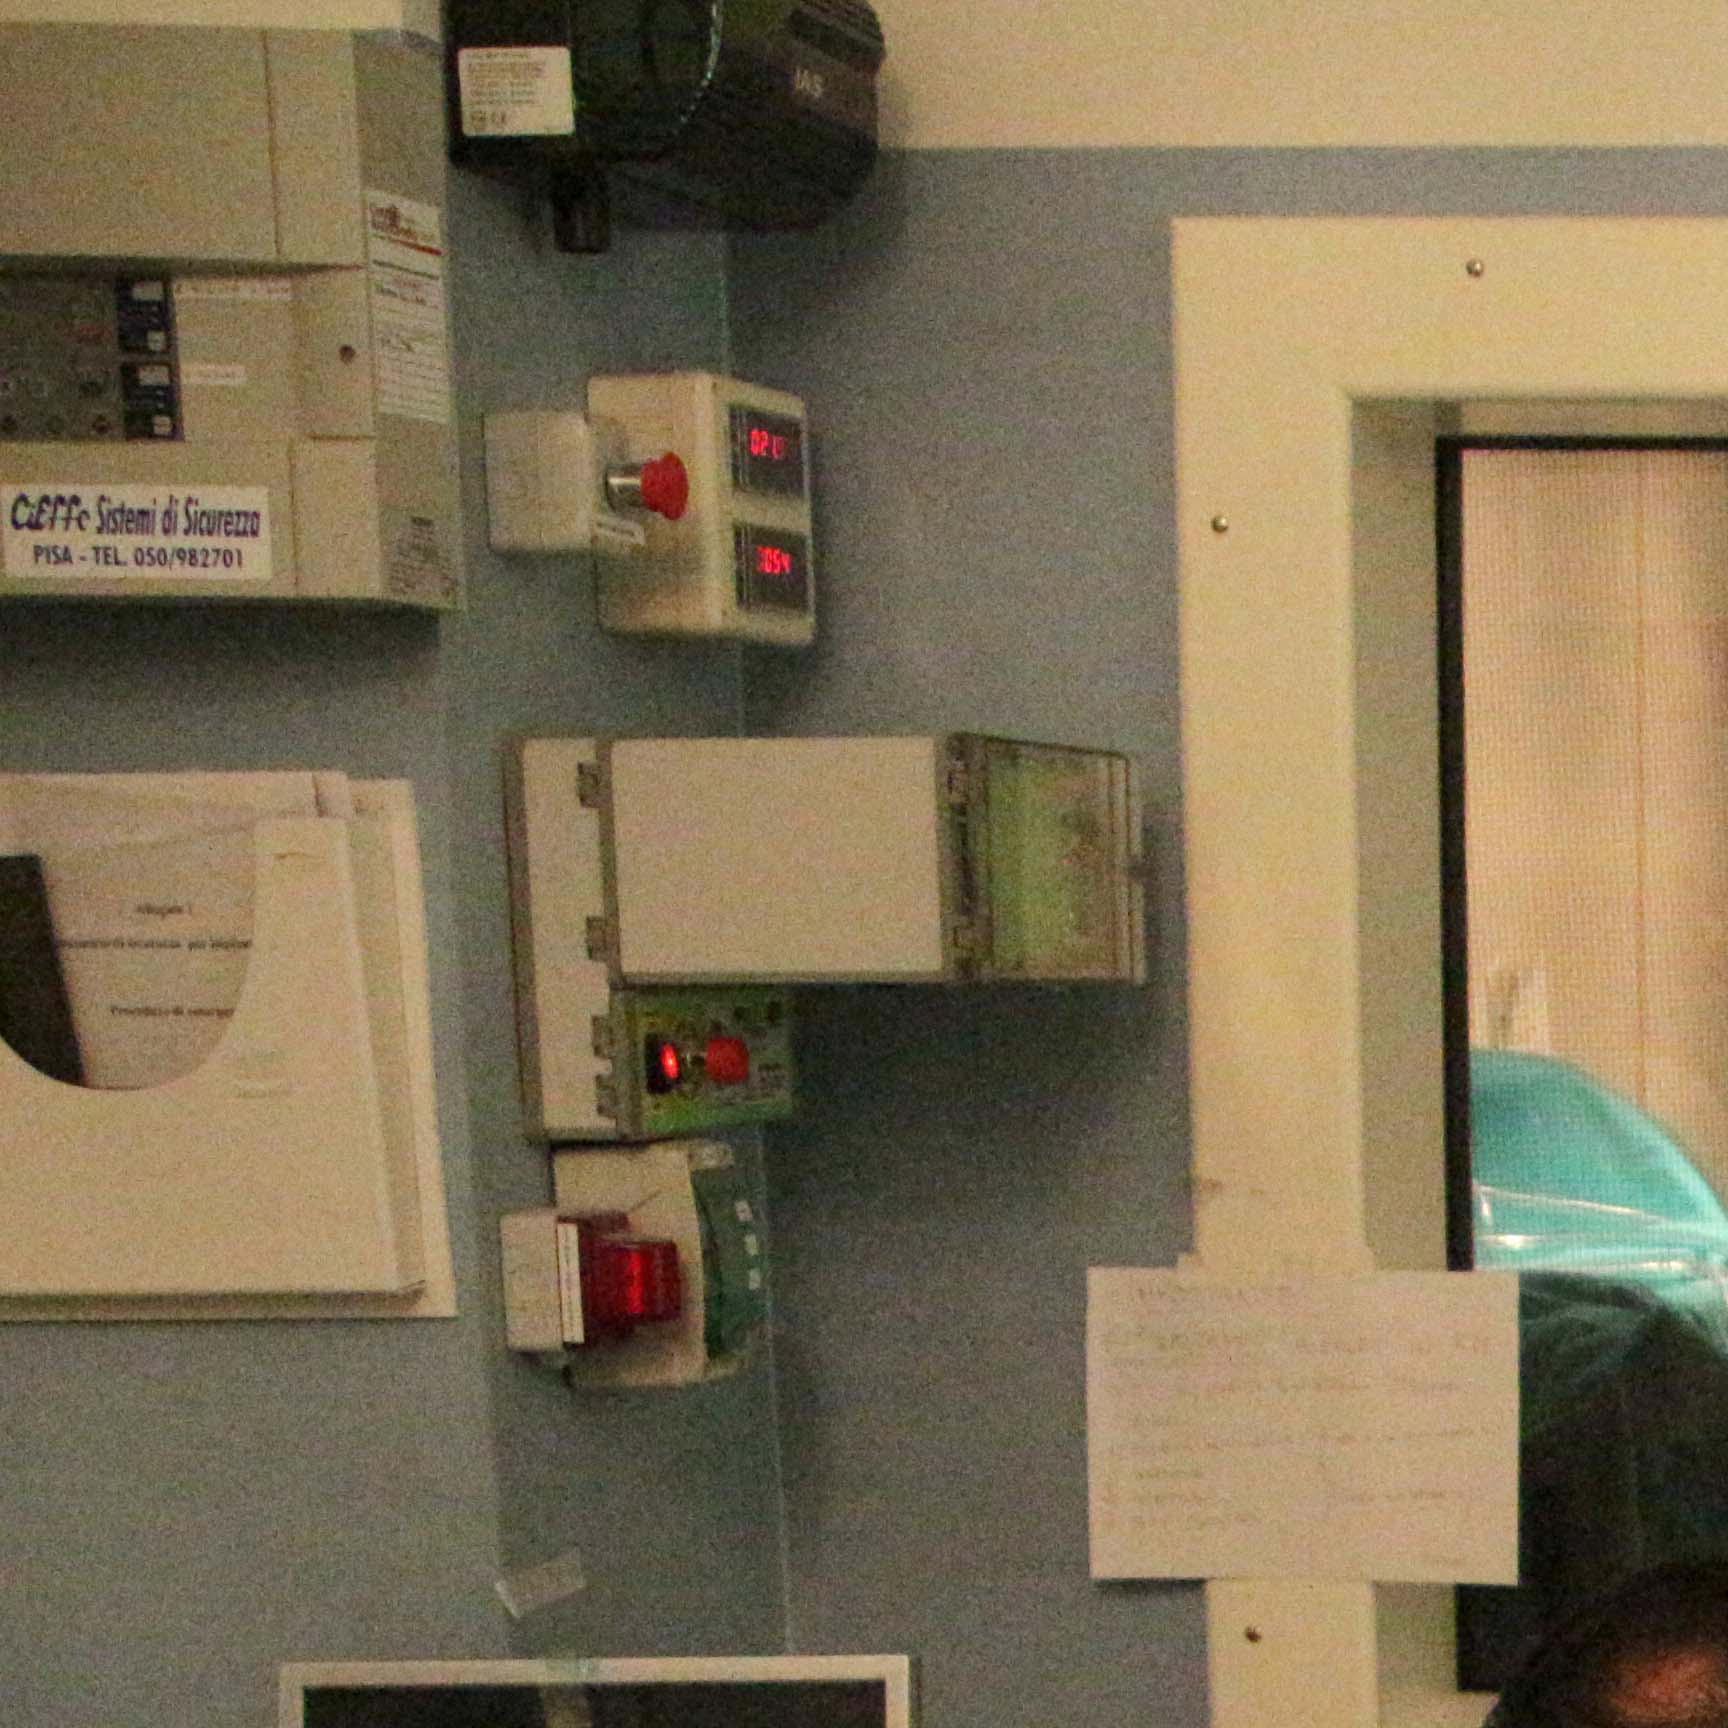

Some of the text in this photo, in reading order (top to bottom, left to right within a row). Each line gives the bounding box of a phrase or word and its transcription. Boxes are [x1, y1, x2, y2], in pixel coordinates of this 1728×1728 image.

[96, 494, 156, 536] Sistemi
[162, 493, 178, 537] di
[183, 494, 261, 538] Sicurezza
[33, 545, 73, 566] PISA
[92, 546, 128, 567] TEL.
[134, 547, 243, 570] 050/982701
